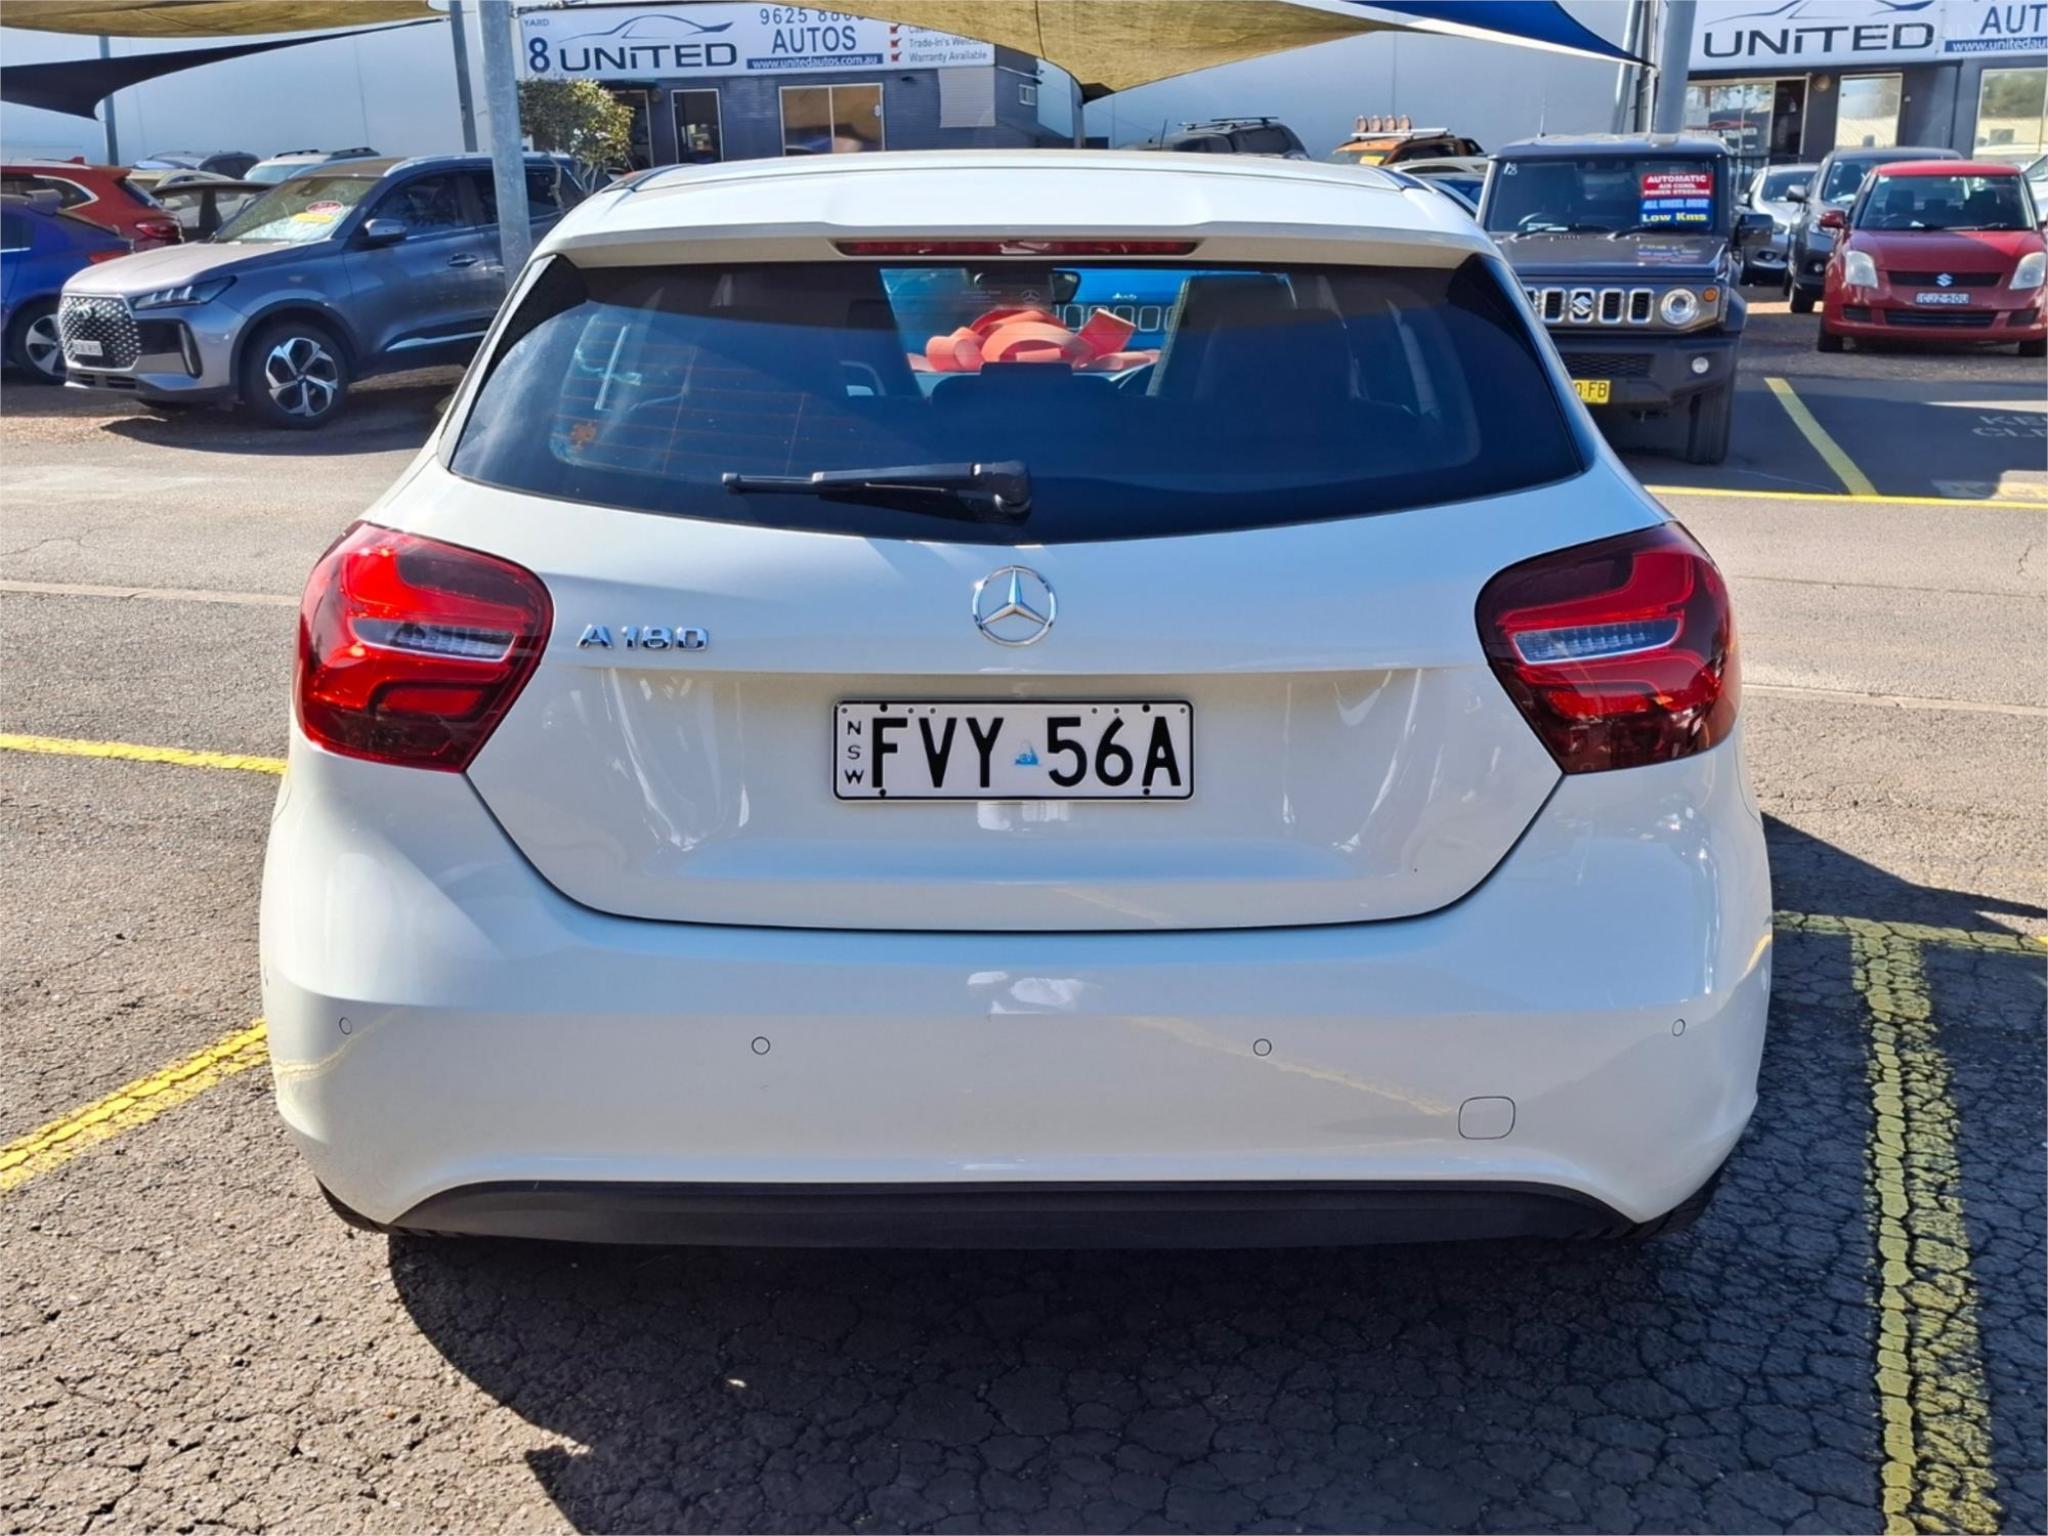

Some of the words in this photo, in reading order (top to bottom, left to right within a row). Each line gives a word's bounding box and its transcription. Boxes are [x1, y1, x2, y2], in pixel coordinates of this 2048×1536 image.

[524, 19, 549, 27] YARD
[760, 8, 807, 25] 9625
[818, 10, 864, 22] 88
[1980, 4, 2047, 35] AUT
[772, 25, 856, 54] AUTOS
[529, 37, 550, 73] 8
[752, 56, 877, 69] www.unitedautos.com.au
[909, 52, 947, 62] Warranty
[949, 50, 987, 60] Available
[1647, 175, 1707, 183] AUTOMATIC
[871, 716, 1004, 788] FVY
[1047, 716, 1182, 788] 56A
